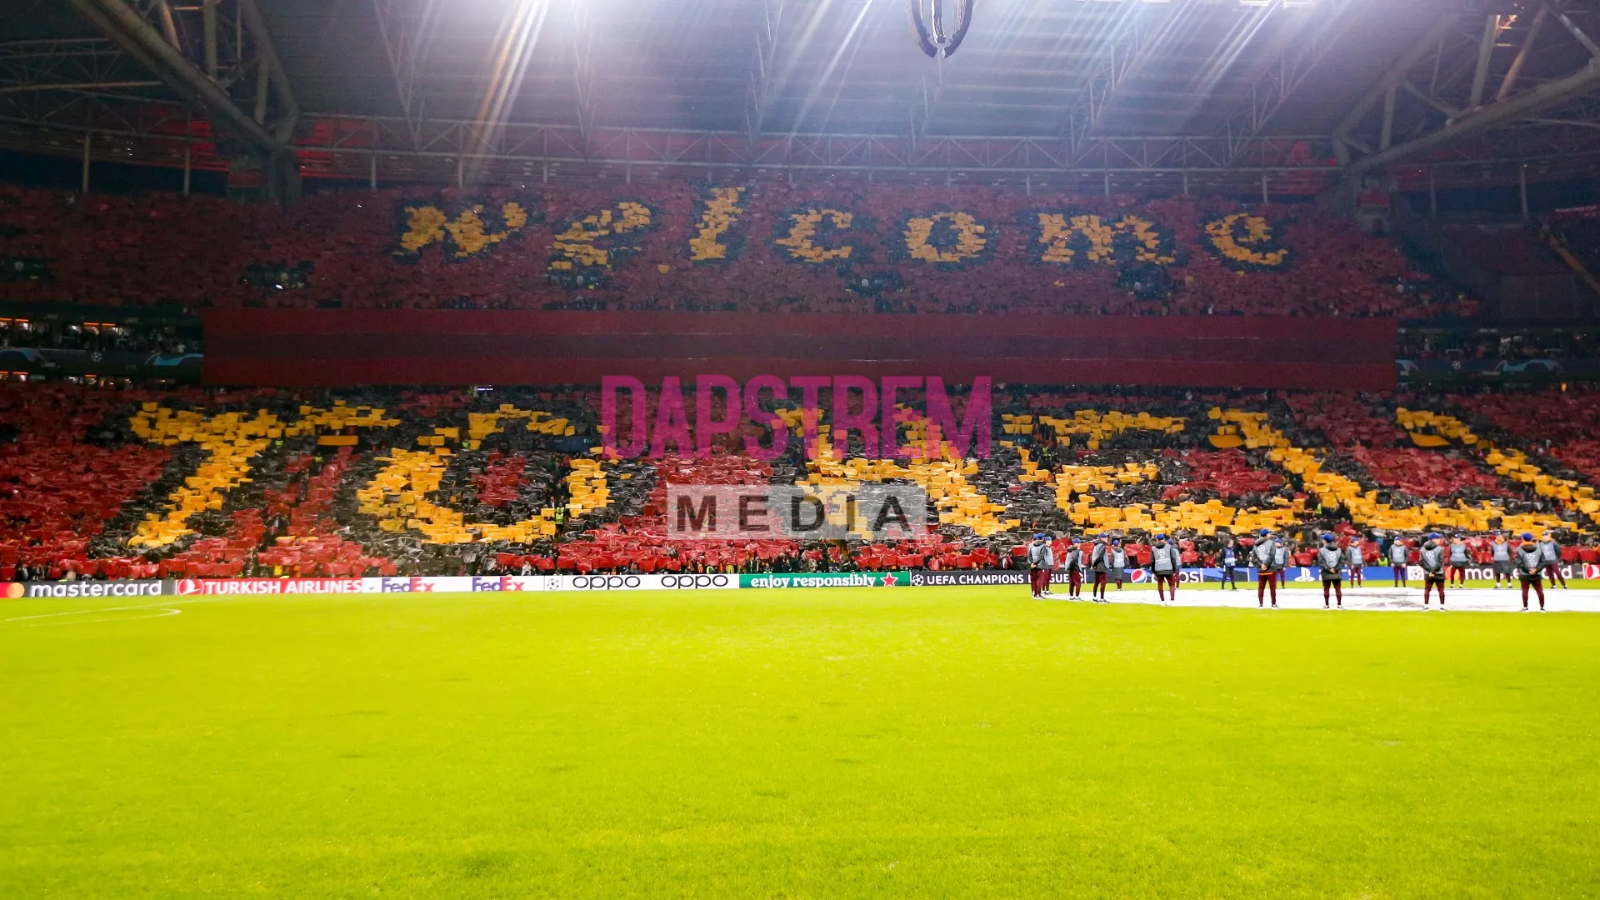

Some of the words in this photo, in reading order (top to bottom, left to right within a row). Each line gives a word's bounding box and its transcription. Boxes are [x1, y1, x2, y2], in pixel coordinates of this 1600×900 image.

[205, 580, 281, 595] TURKISH
[284, 578, 363, 593] AIRLINES
[381, 577, 434, 592] FedEx
[472, 576, 525, 592] FedEx
[572, 575, 641, 590] oppo
[660, 574, 729, 589] oppo
[750, 574, 791, 588] enjoy
[793, 573, 877, 588] responsibly
[927, 574, 957, 585] UEFA
[959, 573, 1025, 585] CHAMPIONS
[30, 581, 162, 597] mastercard
